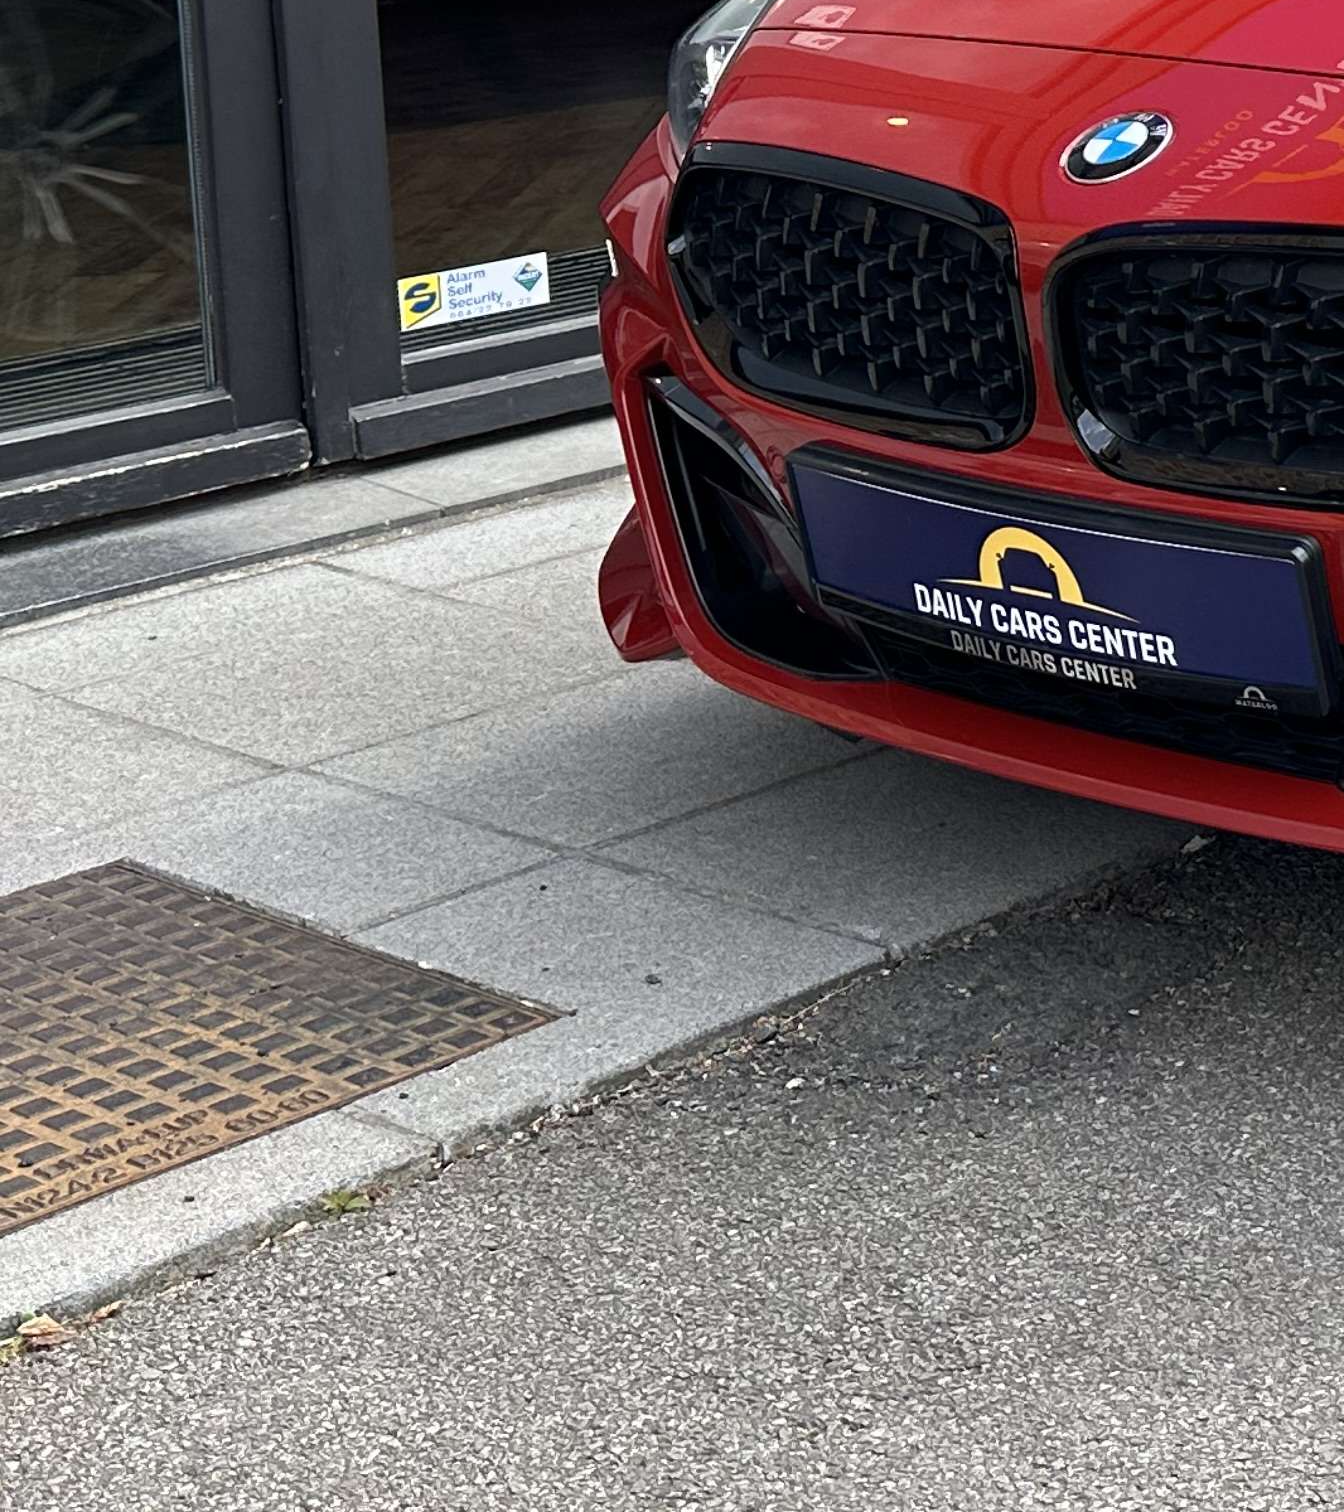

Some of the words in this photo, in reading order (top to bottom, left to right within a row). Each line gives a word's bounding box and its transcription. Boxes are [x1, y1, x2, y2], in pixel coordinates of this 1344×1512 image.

[447, 269, 486, 284] Alarm
[448, 290, 503, 310] Security
[914, 583, 983, 627] DAILY
[990, 602, 1063, 645] CARS
[1068, 619, 1179, 667] CENTER
[950, 630, 1001, 661] DAILY
[1006, 644, 1057, 675] CARS
[1060, 656, 1138, 690] CENTER
